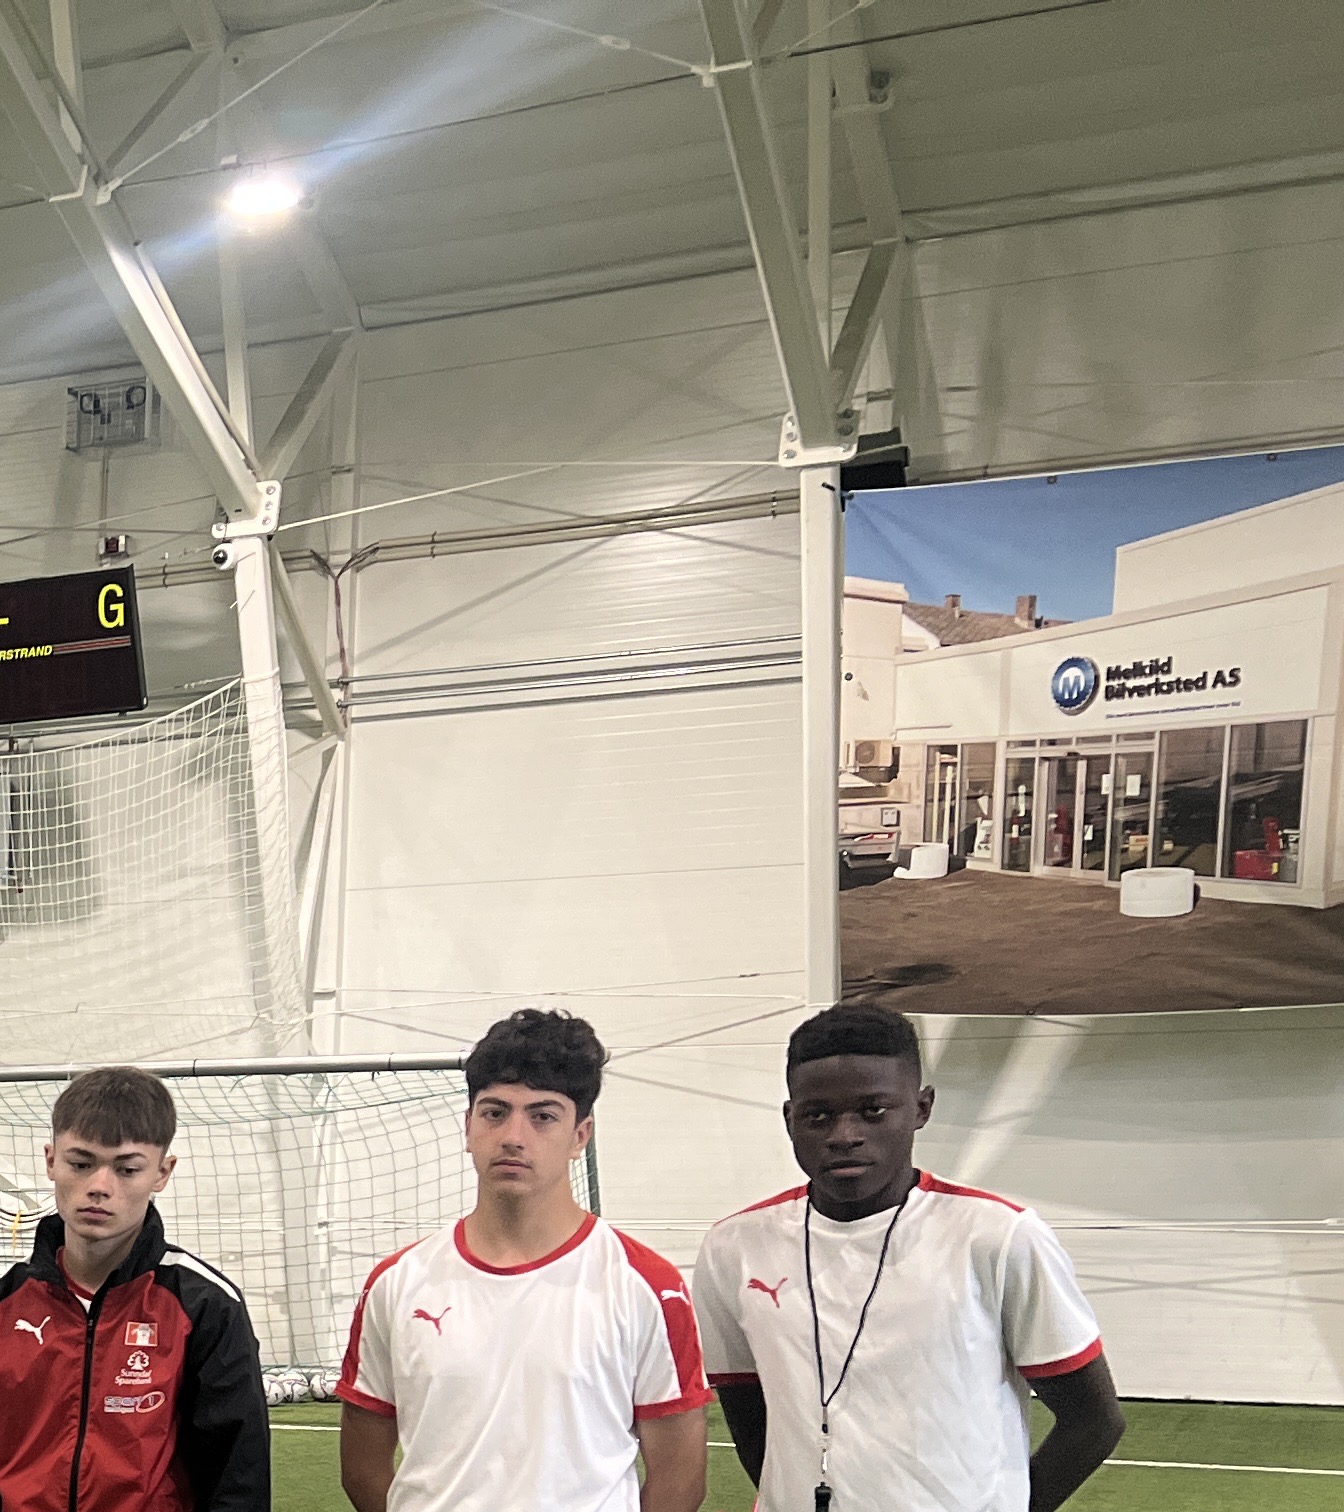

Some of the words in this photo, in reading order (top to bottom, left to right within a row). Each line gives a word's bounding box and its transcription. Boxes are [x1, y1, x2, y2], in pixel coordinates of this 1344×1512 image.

[97, 583, 125, 629] G
[1104, 671, 1208, 702] Bilverksted
[1212, 667, 1242, 689] AS
